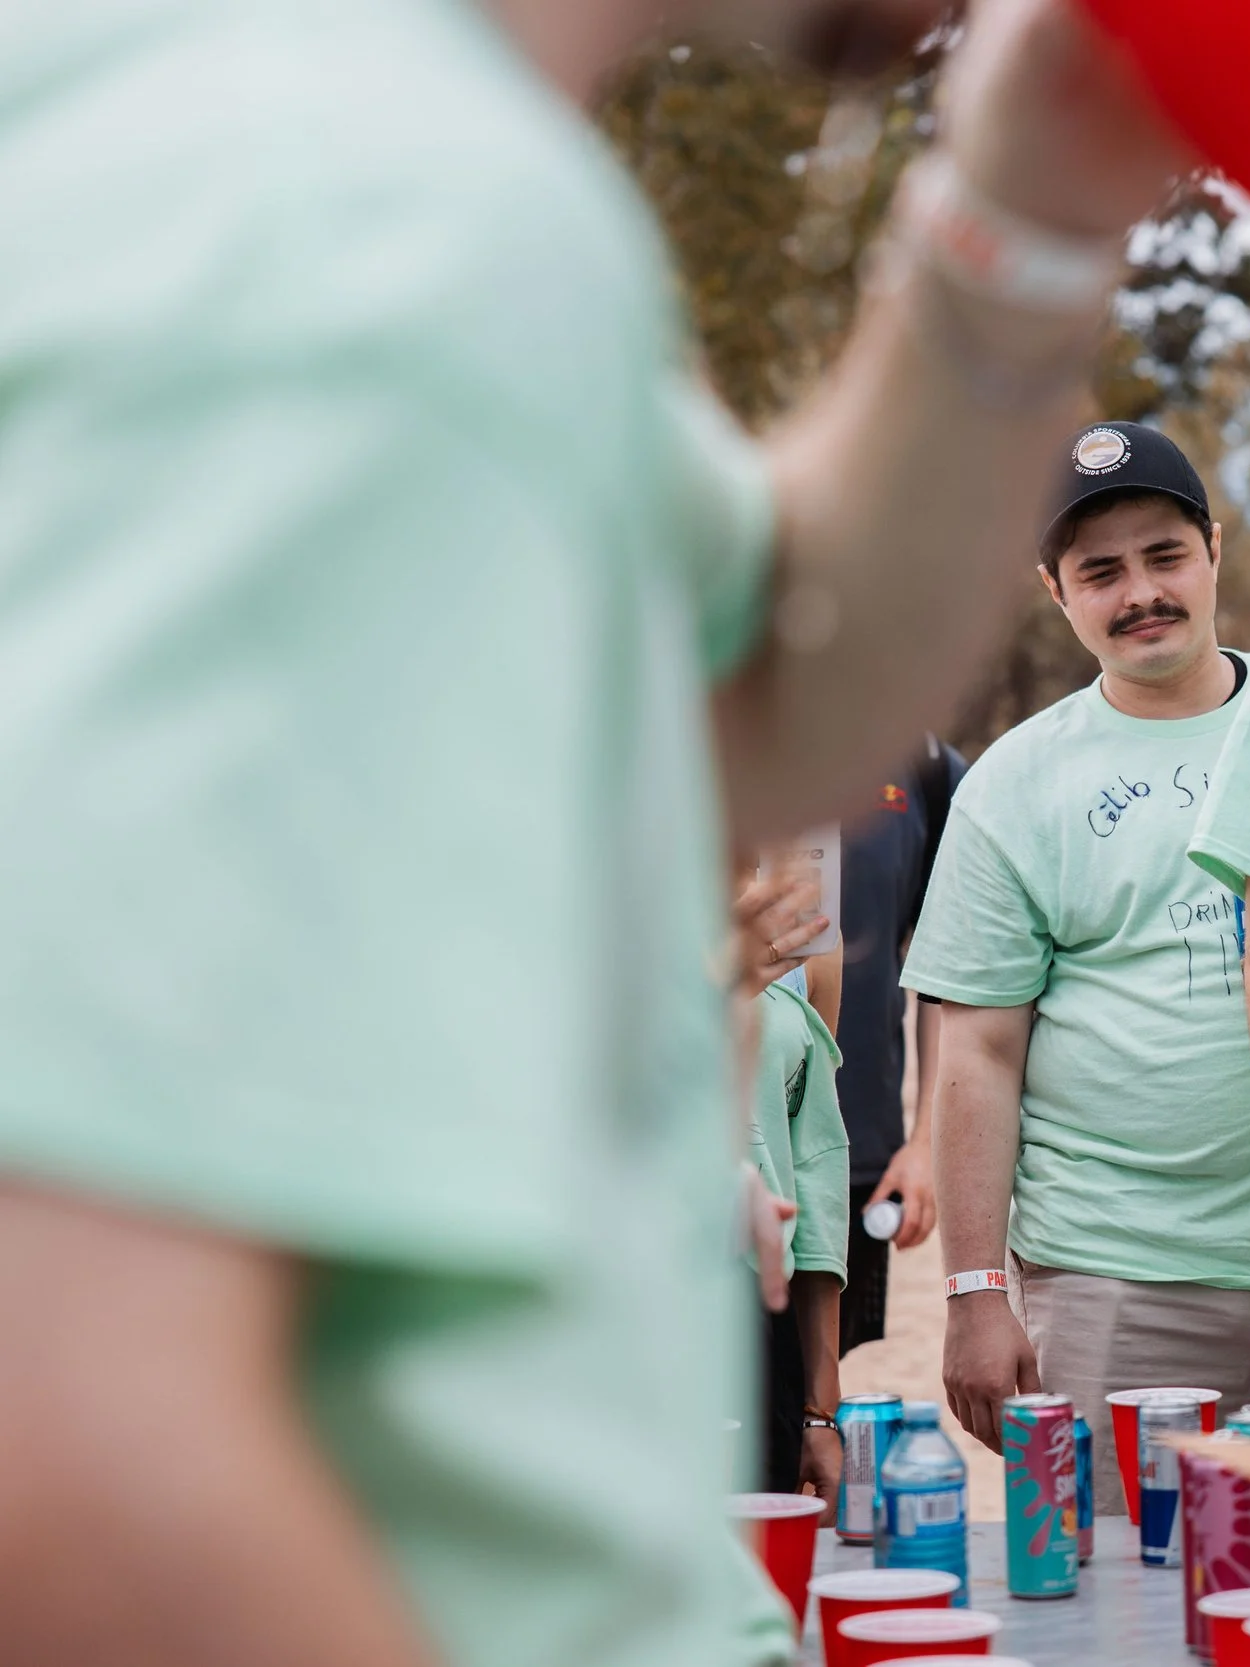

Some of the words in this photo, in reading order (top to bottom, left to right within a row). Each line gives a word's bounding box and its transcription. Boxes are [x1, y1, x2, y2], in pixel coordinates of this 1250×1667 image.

[1072, 431, 1092, 459] COLUMBIA
[1075, 464, 1100, 475] OUTSIDE
[1100, 463, 1121, 474] SINCE
